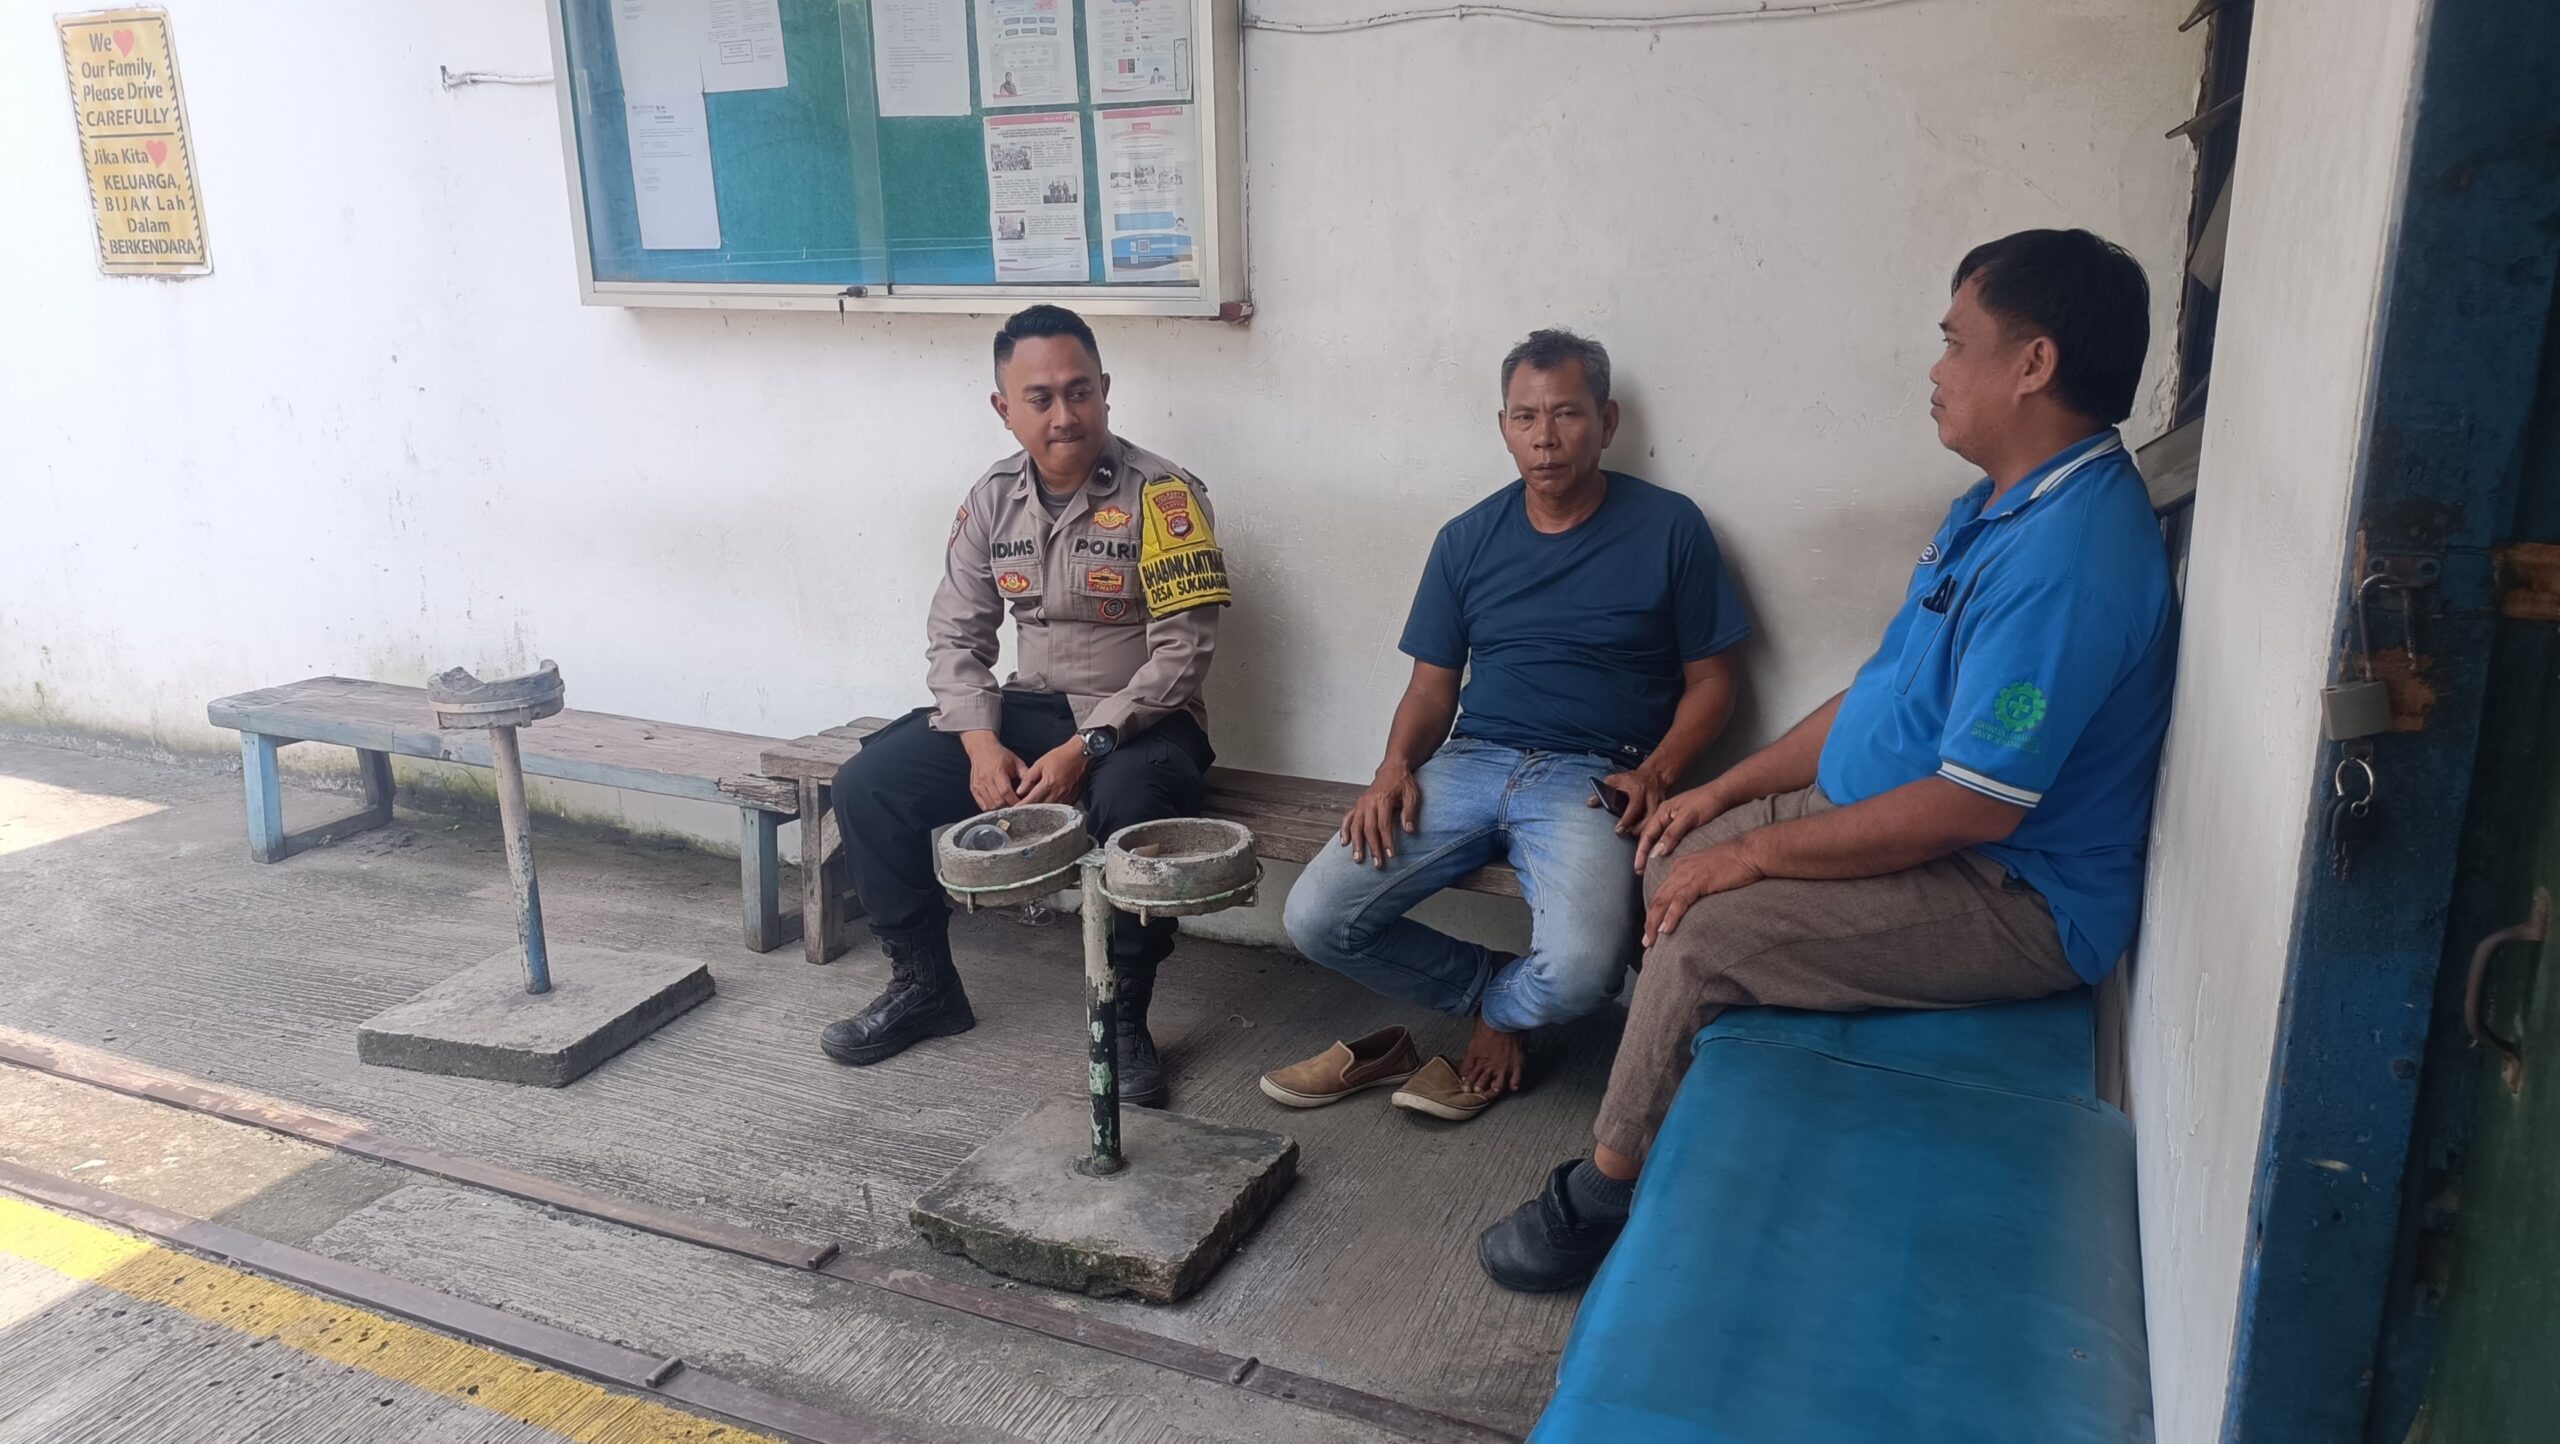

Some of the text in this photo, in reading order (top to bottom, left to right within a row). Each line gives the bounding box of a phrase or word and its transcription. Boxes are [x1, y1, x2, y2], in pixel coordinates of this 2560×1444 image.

[89, 32, 112, 53] We
[81, 57, 156, 80] Our Family,
[83, 81, 163, 102] Please Drive
[86, 107, 169, 127] CAREFULLY
[94, 147, 149, 165] Jika Kita
[103, 173, 181, 191] KELUARGA,
[104, 194, 186, 212] BIJAK Lah
[127, 217, 171, 233] Dalam
[109, 239, 197, 255] BERKENDARA
[1074, 538, 1137, 559] POLRI
[1151, 584, 1174, 604] DESA
